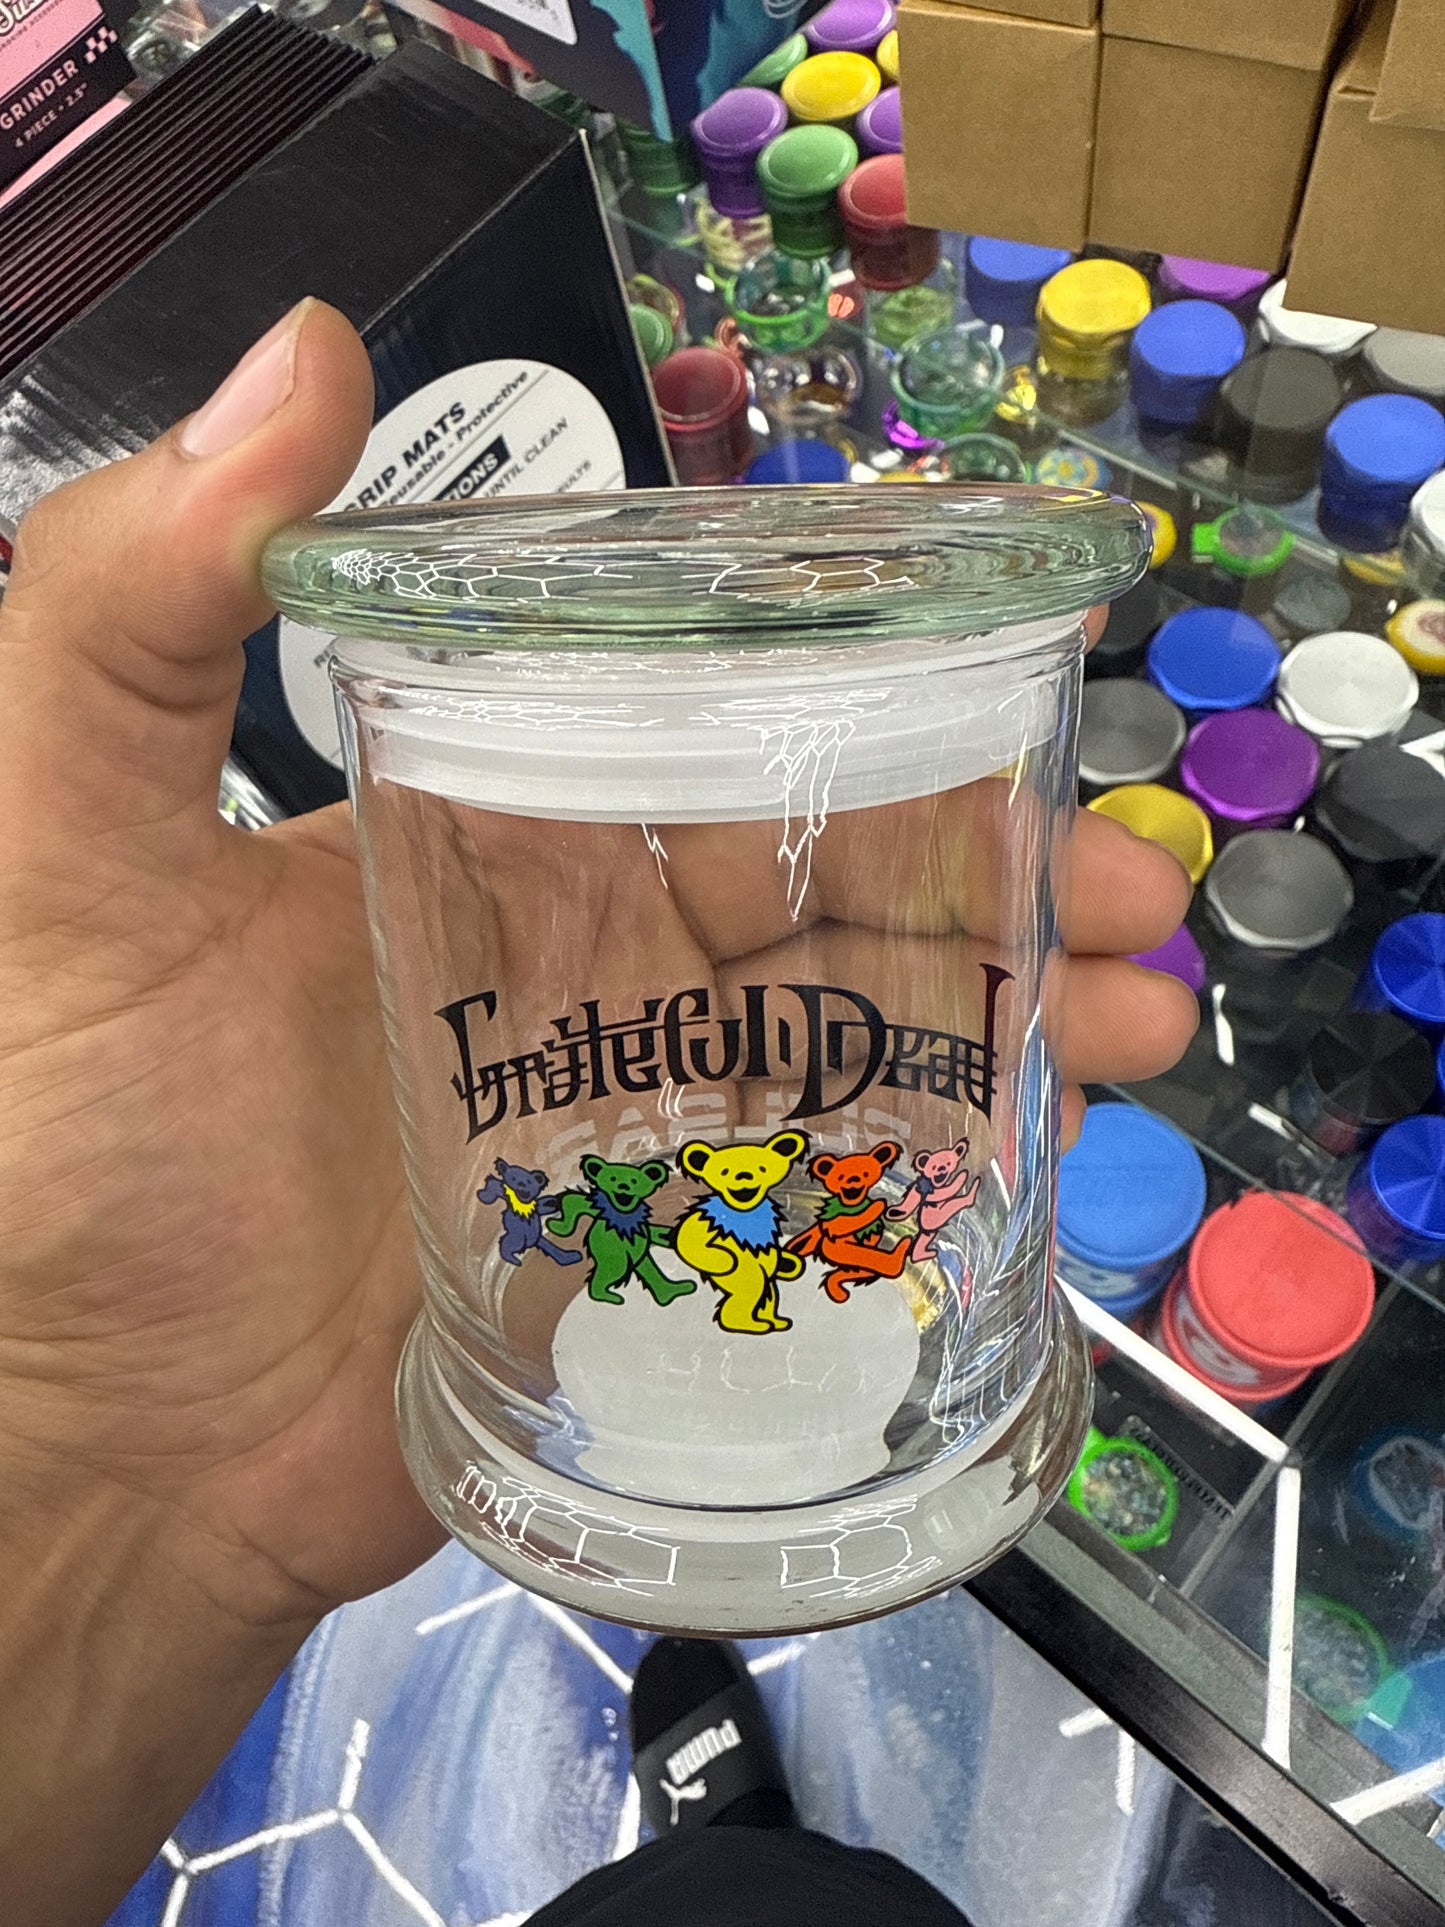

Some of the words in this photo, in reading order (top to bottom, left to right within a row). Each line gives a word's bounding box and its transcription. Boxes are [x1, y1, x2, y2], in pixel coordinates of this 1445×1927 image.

[0, 59, 79, 129] GRINDER
[15, 137, 24, 148] 4
[23, 109, 58, 141] PIECE
[382, 449, 446, 505] eusable
[456, 371, 528, 441] Protective
[402, 401, 466, 469] MATS
[524, 416, 568, 464] CLEAN
[434, 985, 772, 1144] Grateful
[778, 962, 1016, 1124] Dead
[666, 1719, 742, 1785] PUMA
